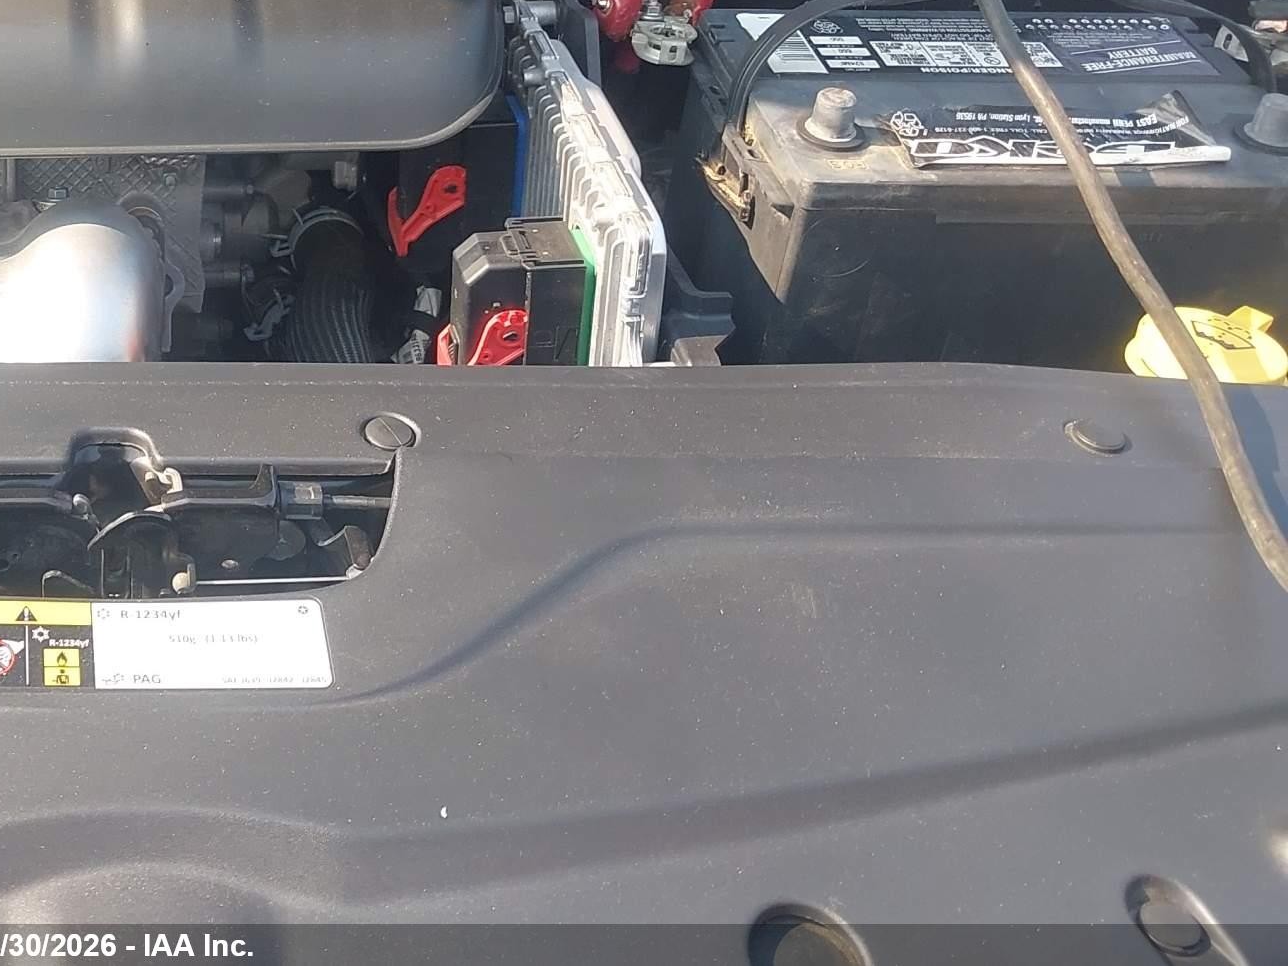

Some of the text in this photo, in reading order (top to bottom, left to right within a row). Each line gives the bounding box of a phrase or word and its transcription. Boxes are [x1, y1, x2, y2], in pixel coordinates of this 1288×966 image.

[1107, 46, 1158, 61] BATTERY
[1081, 50, 1198, 72] MAINTENANCE-FREE
[1015, 113, 1031, 123] Lyon
[1135, 113, 1158, 128] EAST
[48, 638, 90, 649] R-1234yf
[133, 673, 162, 685] PAG
